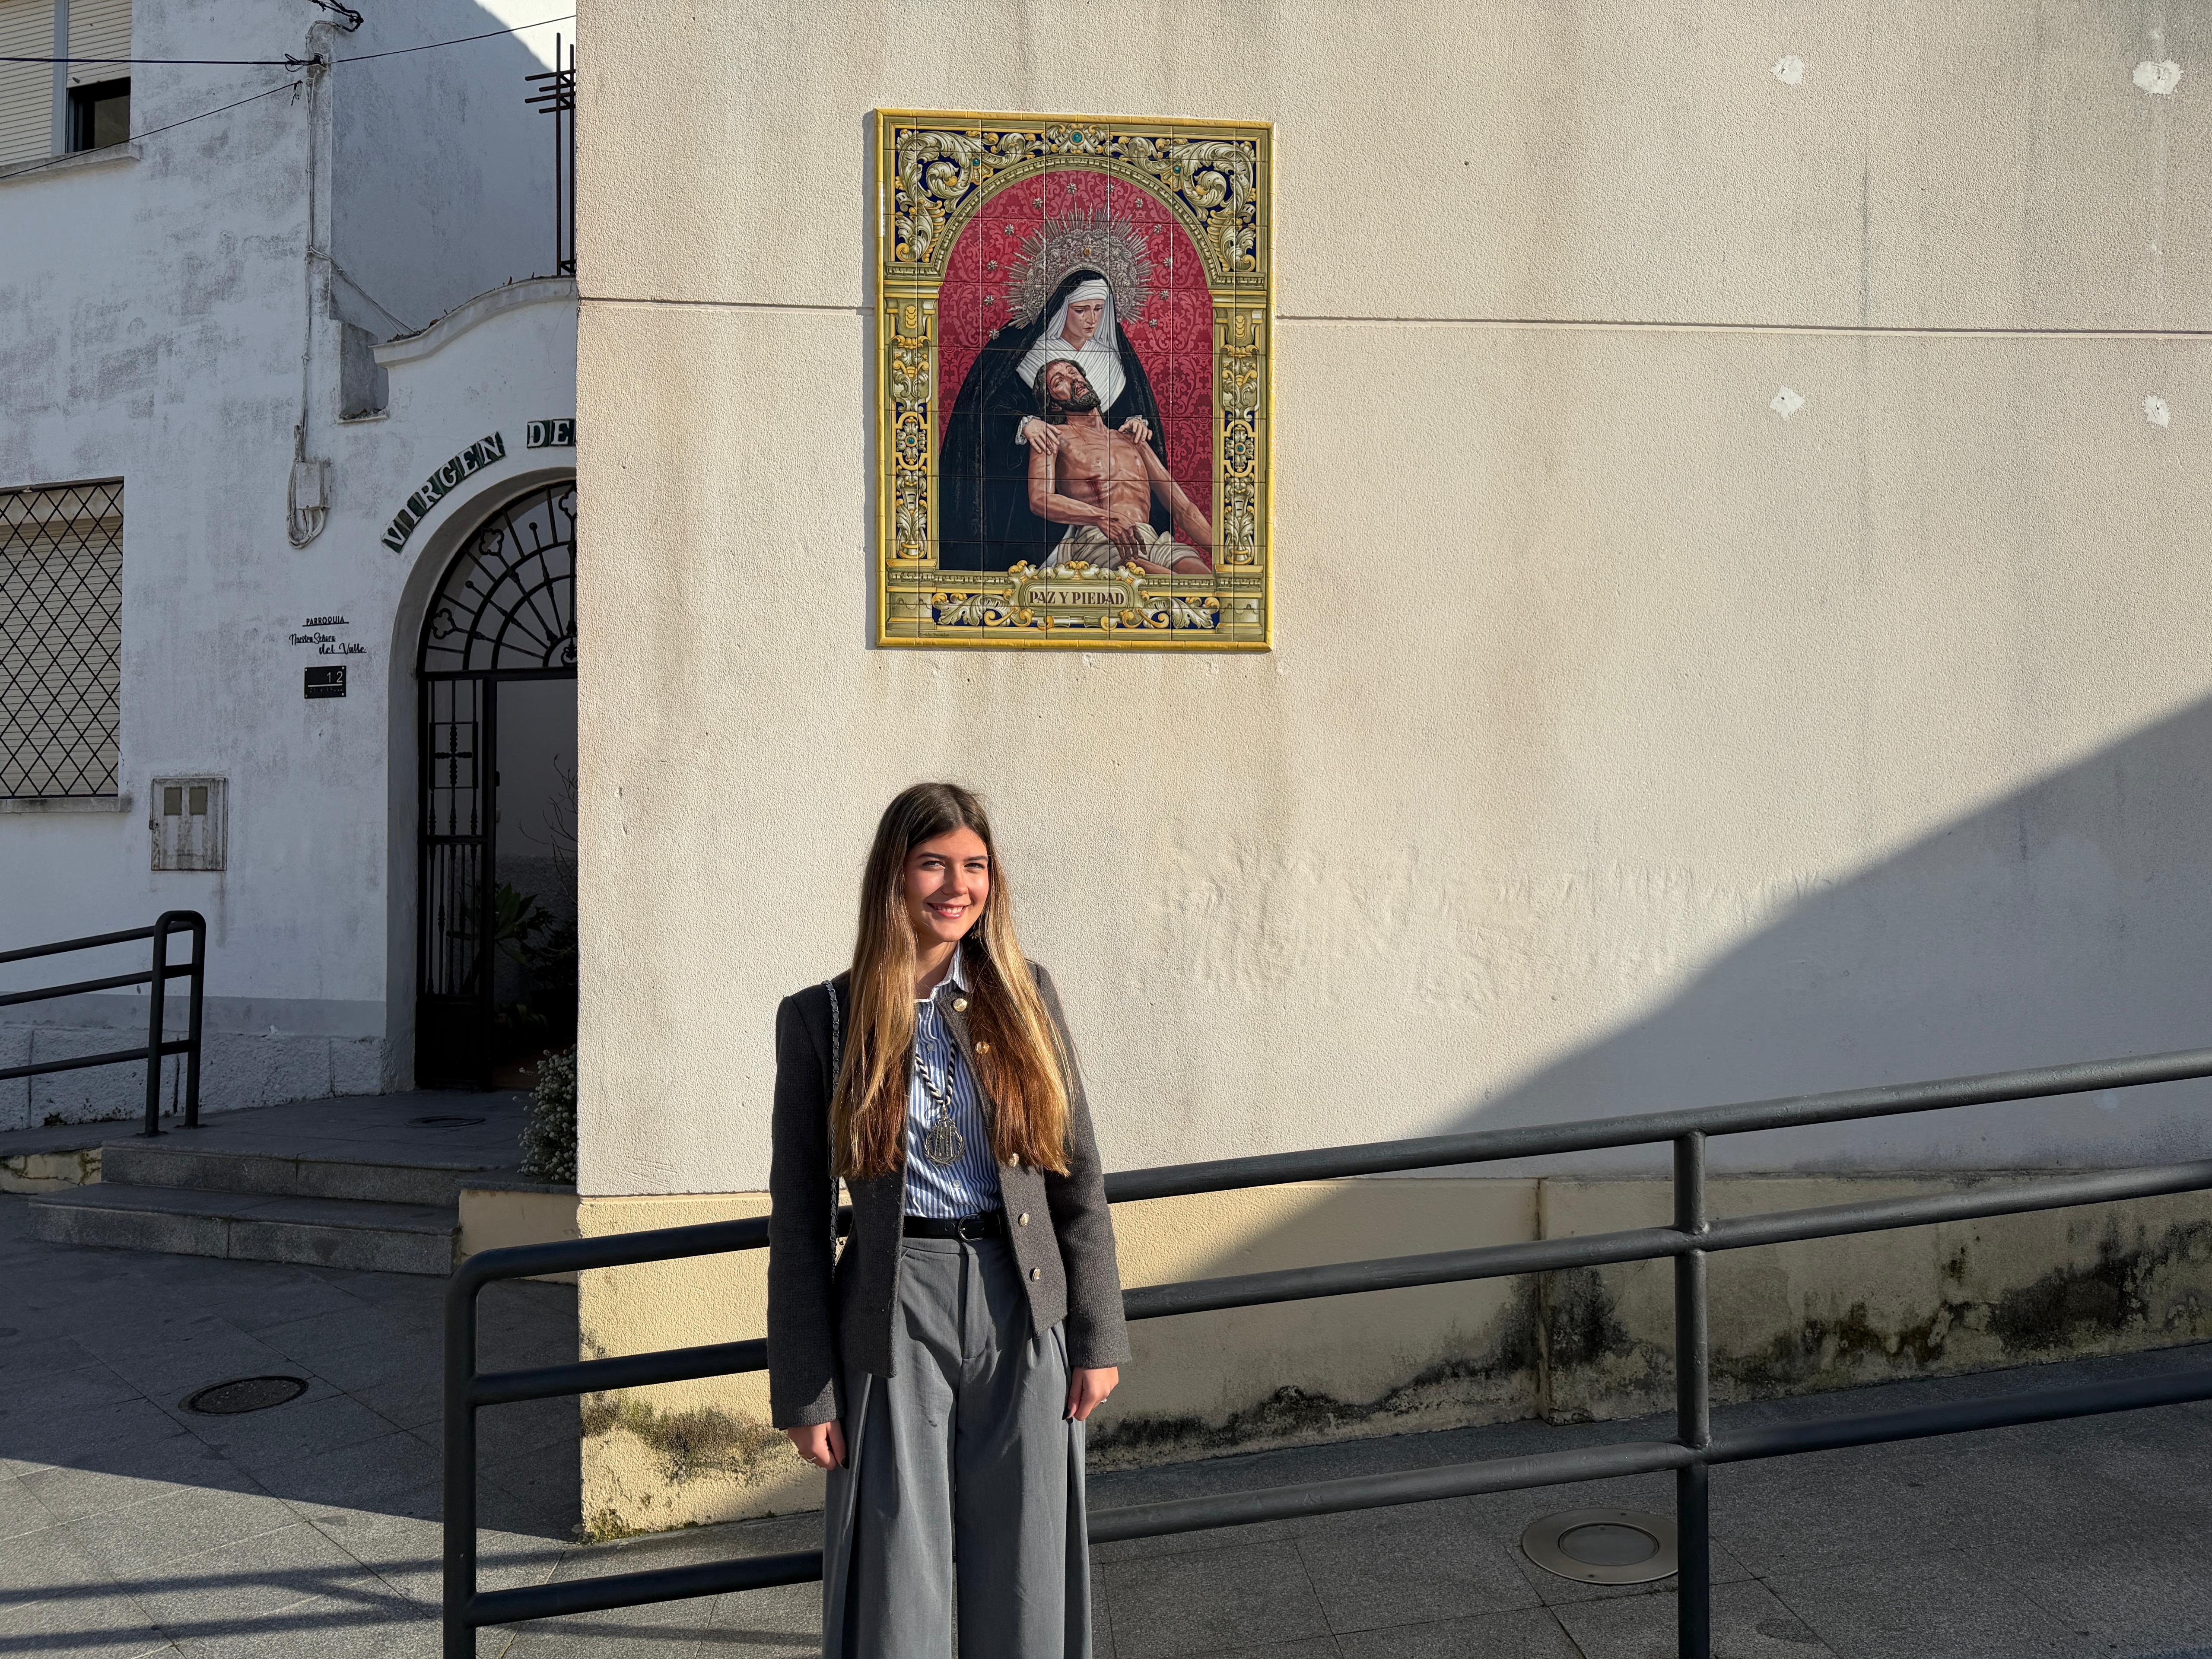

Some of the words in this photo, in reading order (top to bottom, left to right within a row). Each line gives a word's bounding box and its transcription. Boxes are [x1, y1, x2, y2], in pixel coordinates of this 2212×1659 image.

[382, 432, 504, 546] VIRGEN
[527, 420, 577, 447] DE
[1030, 591, 1055, 604] PAZ
[1058, 591, 1069, 604] Y
[1071, 591, 1125, 605] PIEDAD
[306, 616, 345, 626] PARROQUIA
[289, 633, 314, 645] Nuestra
[319, 643, 335, 655] del
[339, 642, 367, 655] Valle
[327, 671, 343, 683] 12
